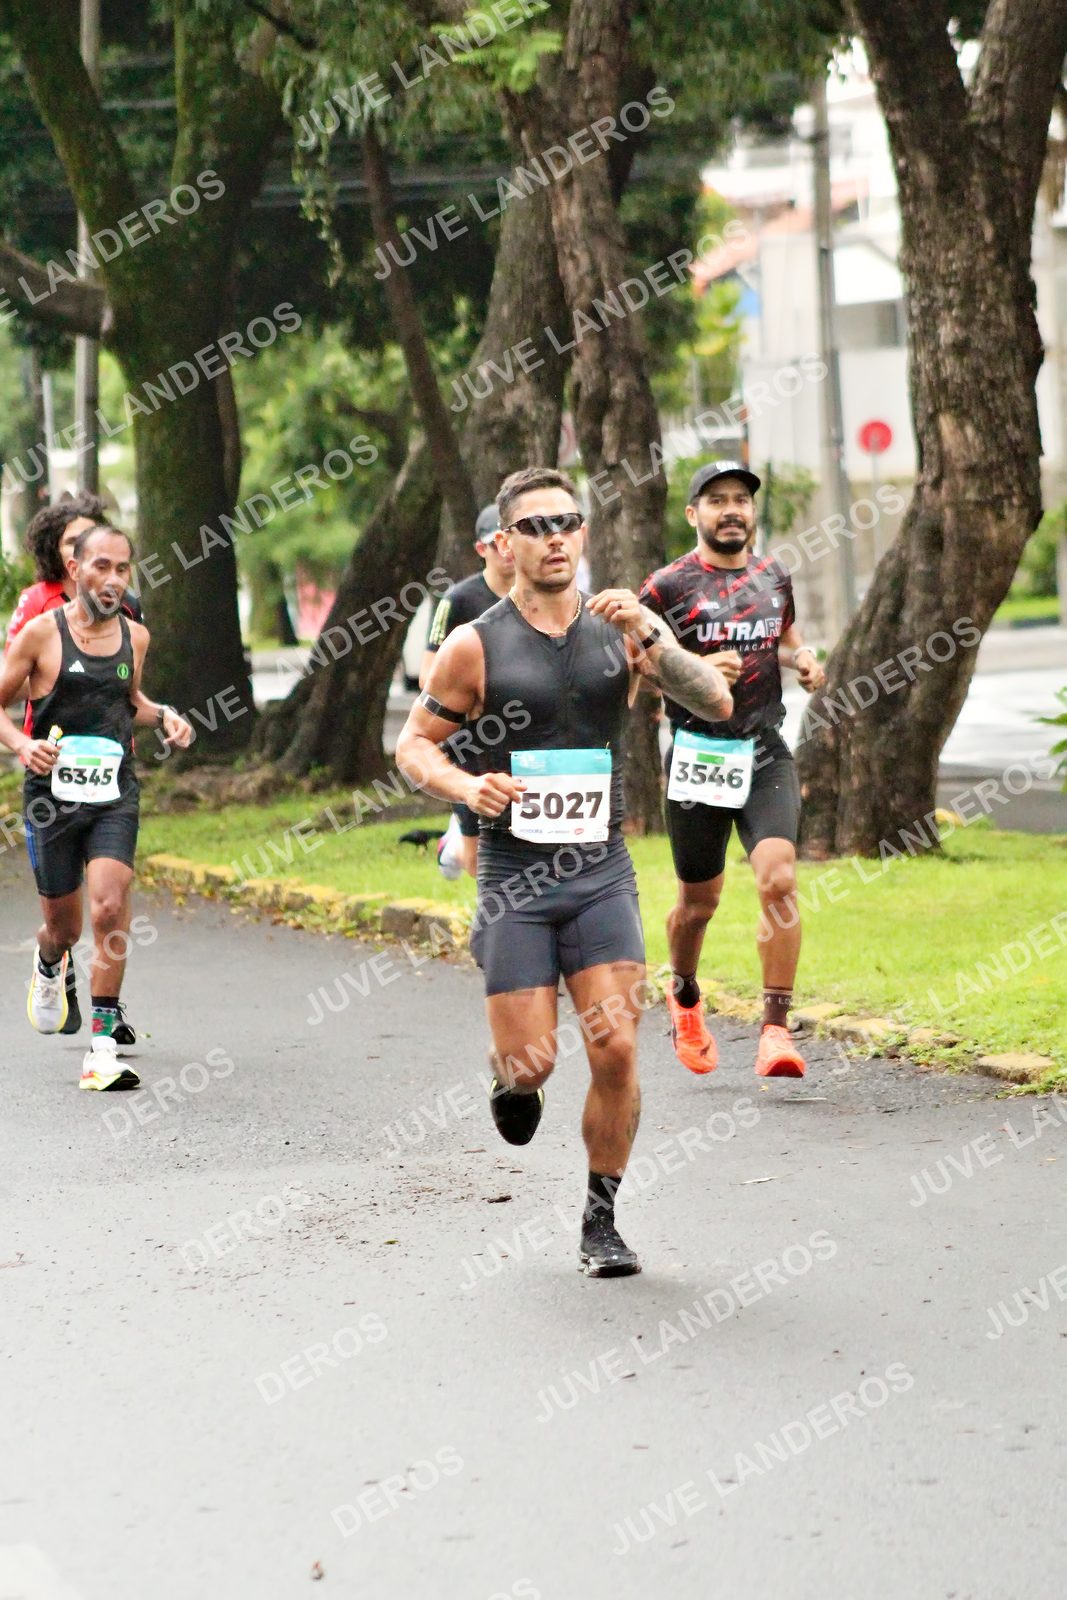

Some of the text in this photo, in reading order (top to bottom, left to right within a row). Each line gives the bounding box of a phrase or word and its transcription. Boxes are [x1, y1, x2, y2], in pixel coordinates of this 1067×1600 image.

[58, 766, 113, 787] 6345
[675, 761, 744, 789] 3546
[520, 791, 603, 820] 5027
